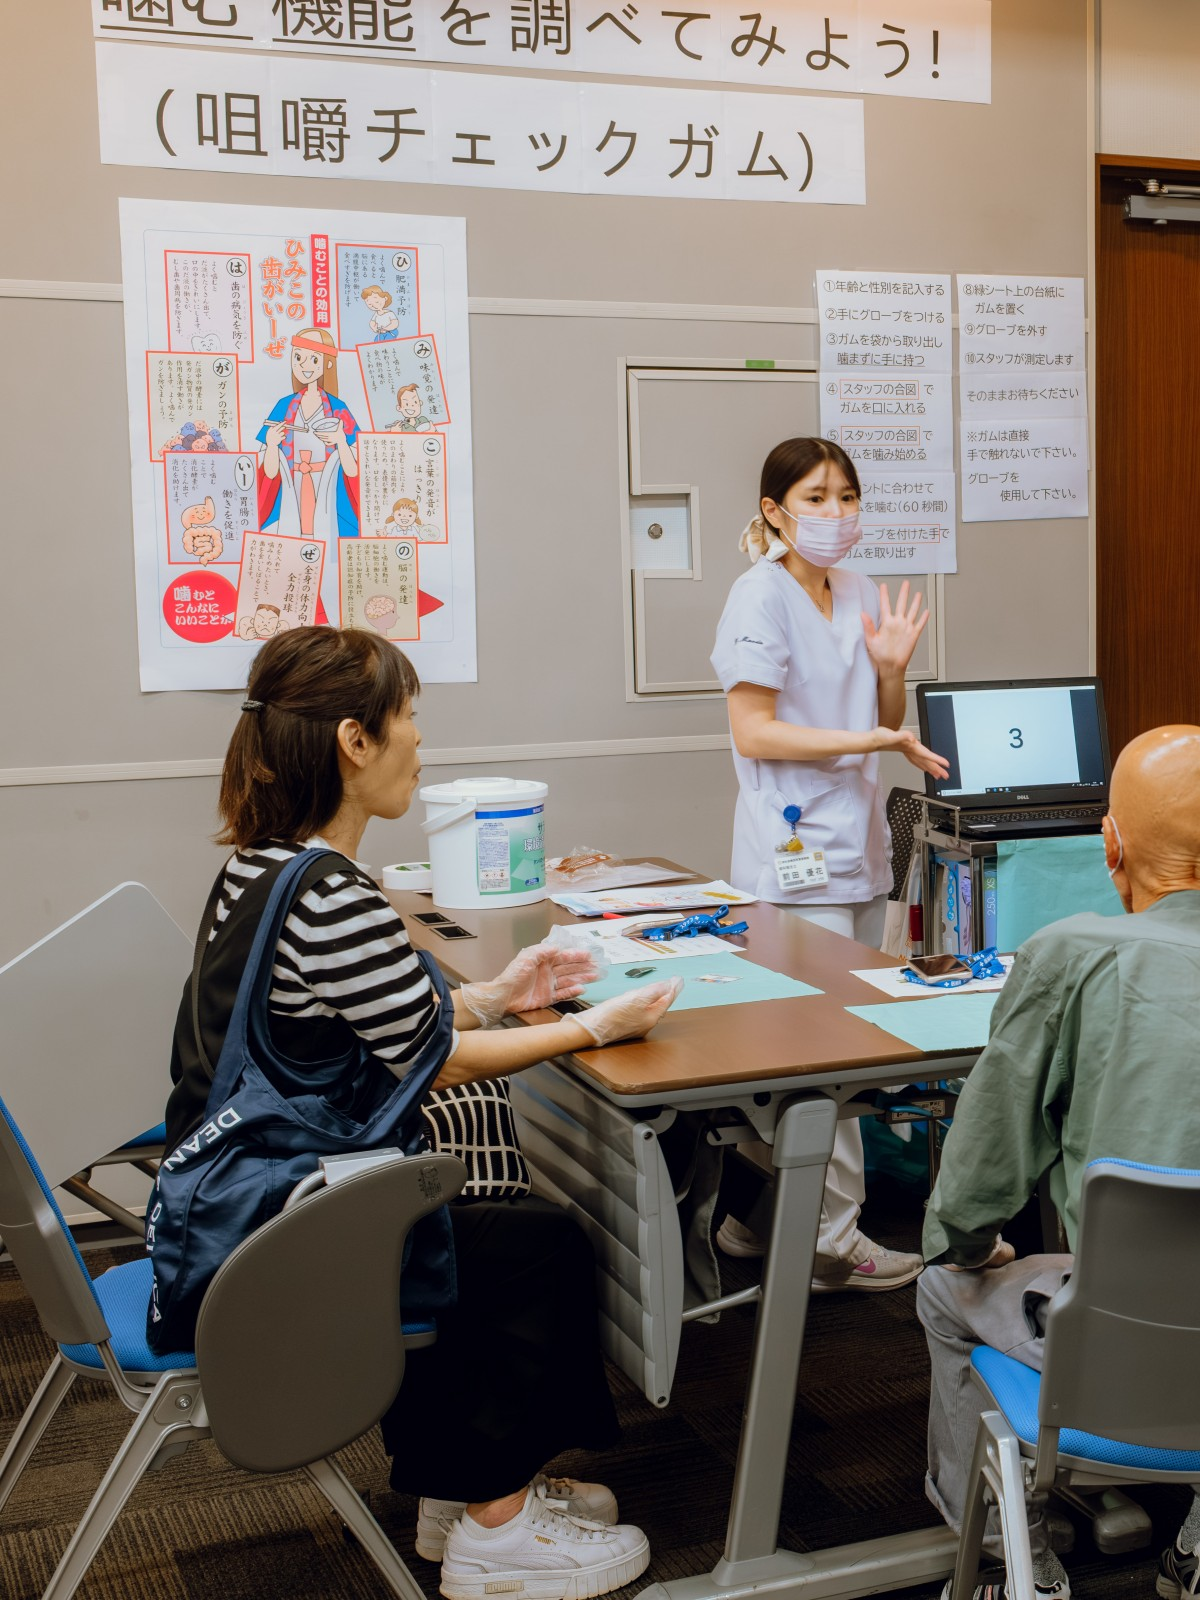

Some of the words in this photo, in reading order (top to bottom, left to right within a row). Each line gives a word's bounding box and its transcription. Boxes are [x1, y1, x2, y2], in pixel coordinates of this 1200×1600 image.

[155, 88, 814, 192] (咀嚼チェックガム)
[229, 261, 243, 274] は
[396, 256, 408, 268] ひ
[284, 239, 307, 320] ひみこの
[314, 238, 328, 323] 噛むことの効用
[396, 274, 407, 316] 肥満予防
[260, 256, 287, 359] 歯がいーぜ
[975, 303, 1025, 315] ガムを置く
[231, 281, 242, 350] 歯の病気を防ぐ
[965, 323, 1047, 336] ⑨グローブを外す
[416, 343, 430, 356] み
[837, 352, 925, 366] 噛まずに手に持つ
[216, 361, 230, 374] が
[419, 362, 440, 415] 味覚の発達
[843, 383, 917, 396] スタッフの合図
[967, 388, 1079, 402] そのままお待ちください
[218, 380, 228, 429] ガンの予防
[840, 402, 926, 414] ガムを口に入れる
[844, 429, 918, 442] スタッフの合図
[967, 429, 1030, 442] ※ガムは直接
[426, 441, 436, 452] こ
[967, 446, 1077, 461] 手で触れないで下さい。
[237, 462, 251, 487] いー
[968, 472, 1020, 484] グローブを
[414, 464, 422, 504] はっきり
[425, 458, 435, 517] 言葉の発音が
[860, 482, 934, 495] ントに合わせて
[1000, 488, 1077, 502] 使用して下さい。
[222, 489, 235, 541] 働きを促進
[240, 496, 249, 526] 胃腸の
[860, 528, 950, 540] ーブを付けた手で
[302, 547, 317, 560] ぜ
[398, 545, 410, 556] の
[398, 563, 408, 605] 脳の発達
[174, 585, 215, 602] 噛むと
[282, 572, 297, 613] 全力投球
[175, 603, 219, 613] こんなに
[1009, 728, 1024, 749] 3
[987, 877, 996, 889] XS
[163, 1107, 243, 1171] DEAN
